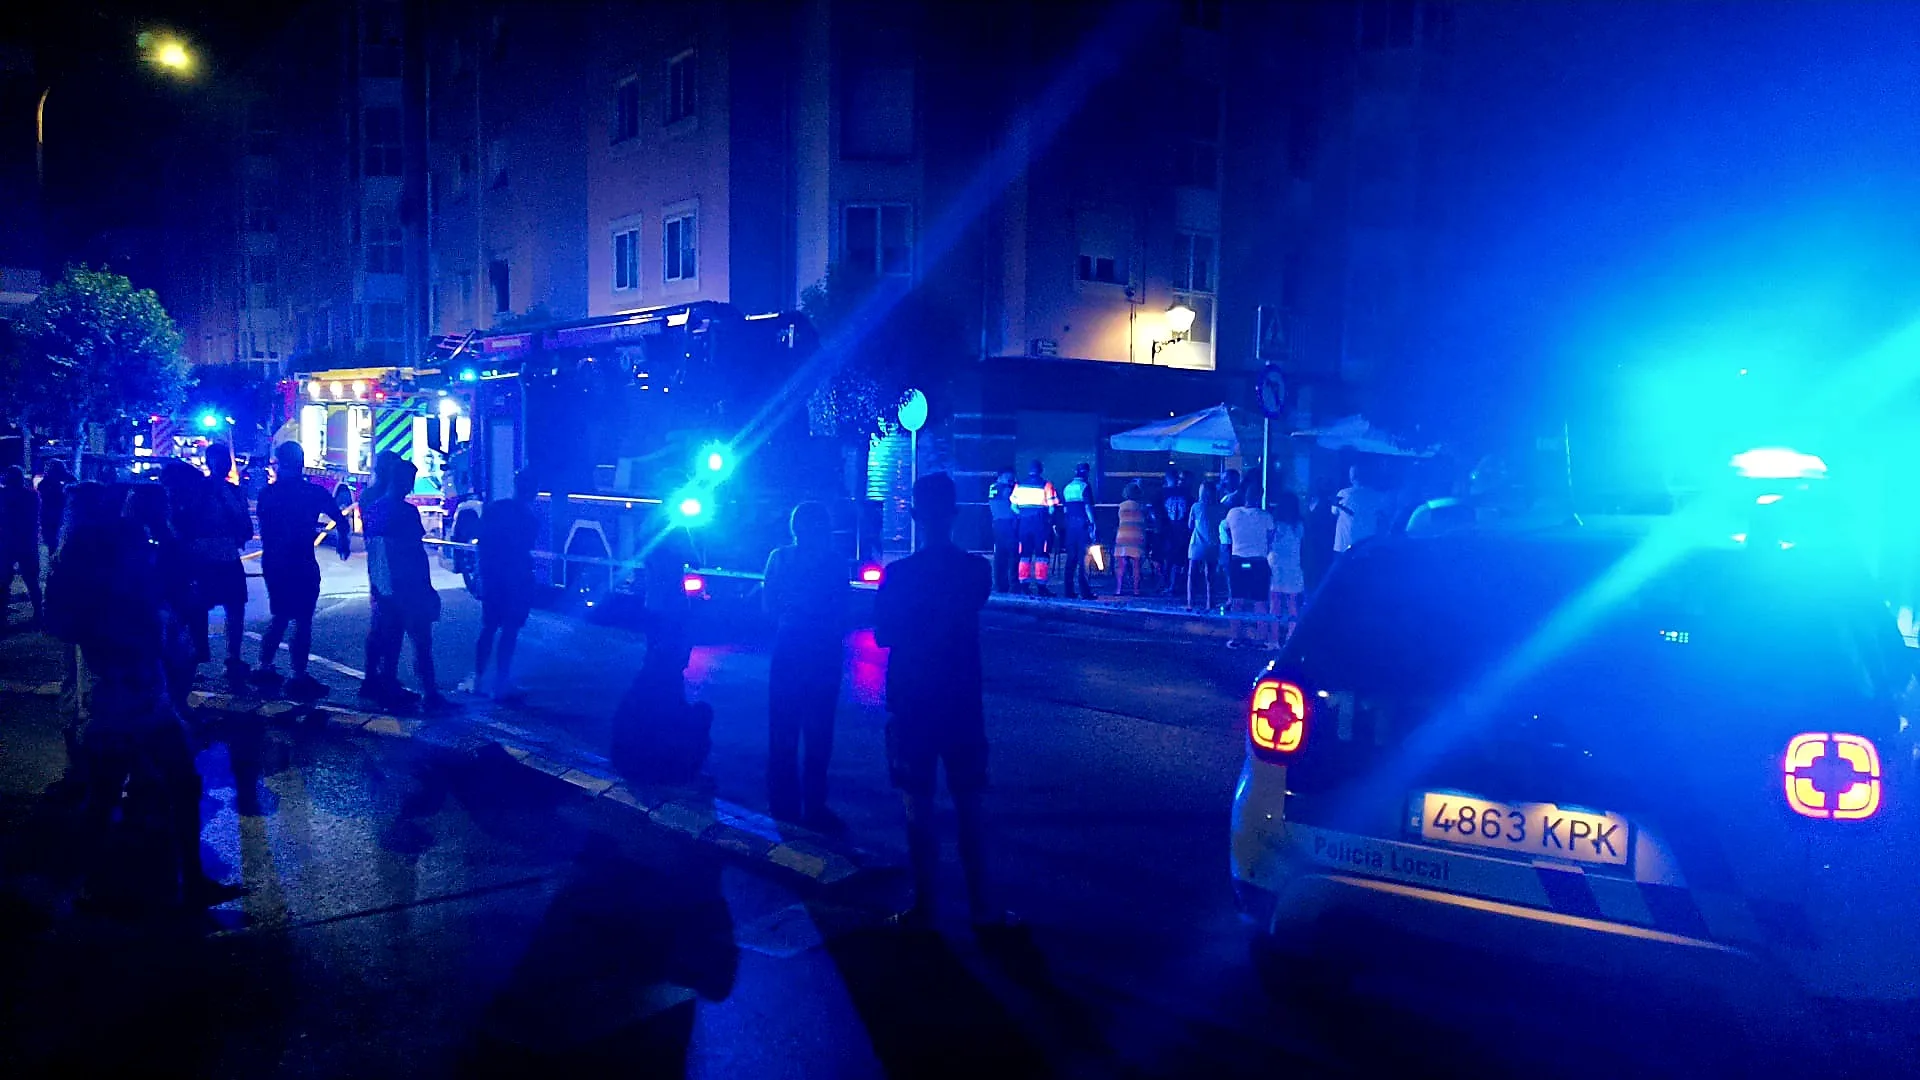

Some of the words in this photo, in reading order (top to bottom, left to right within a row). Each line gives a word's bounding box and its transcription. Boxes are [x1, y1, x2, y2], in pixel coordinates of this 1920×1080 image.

[1432, 802, 1526, 843] 4863
[1542, 815, 1619, 857] KPK
[1390, 848, 1450, 881] Local
